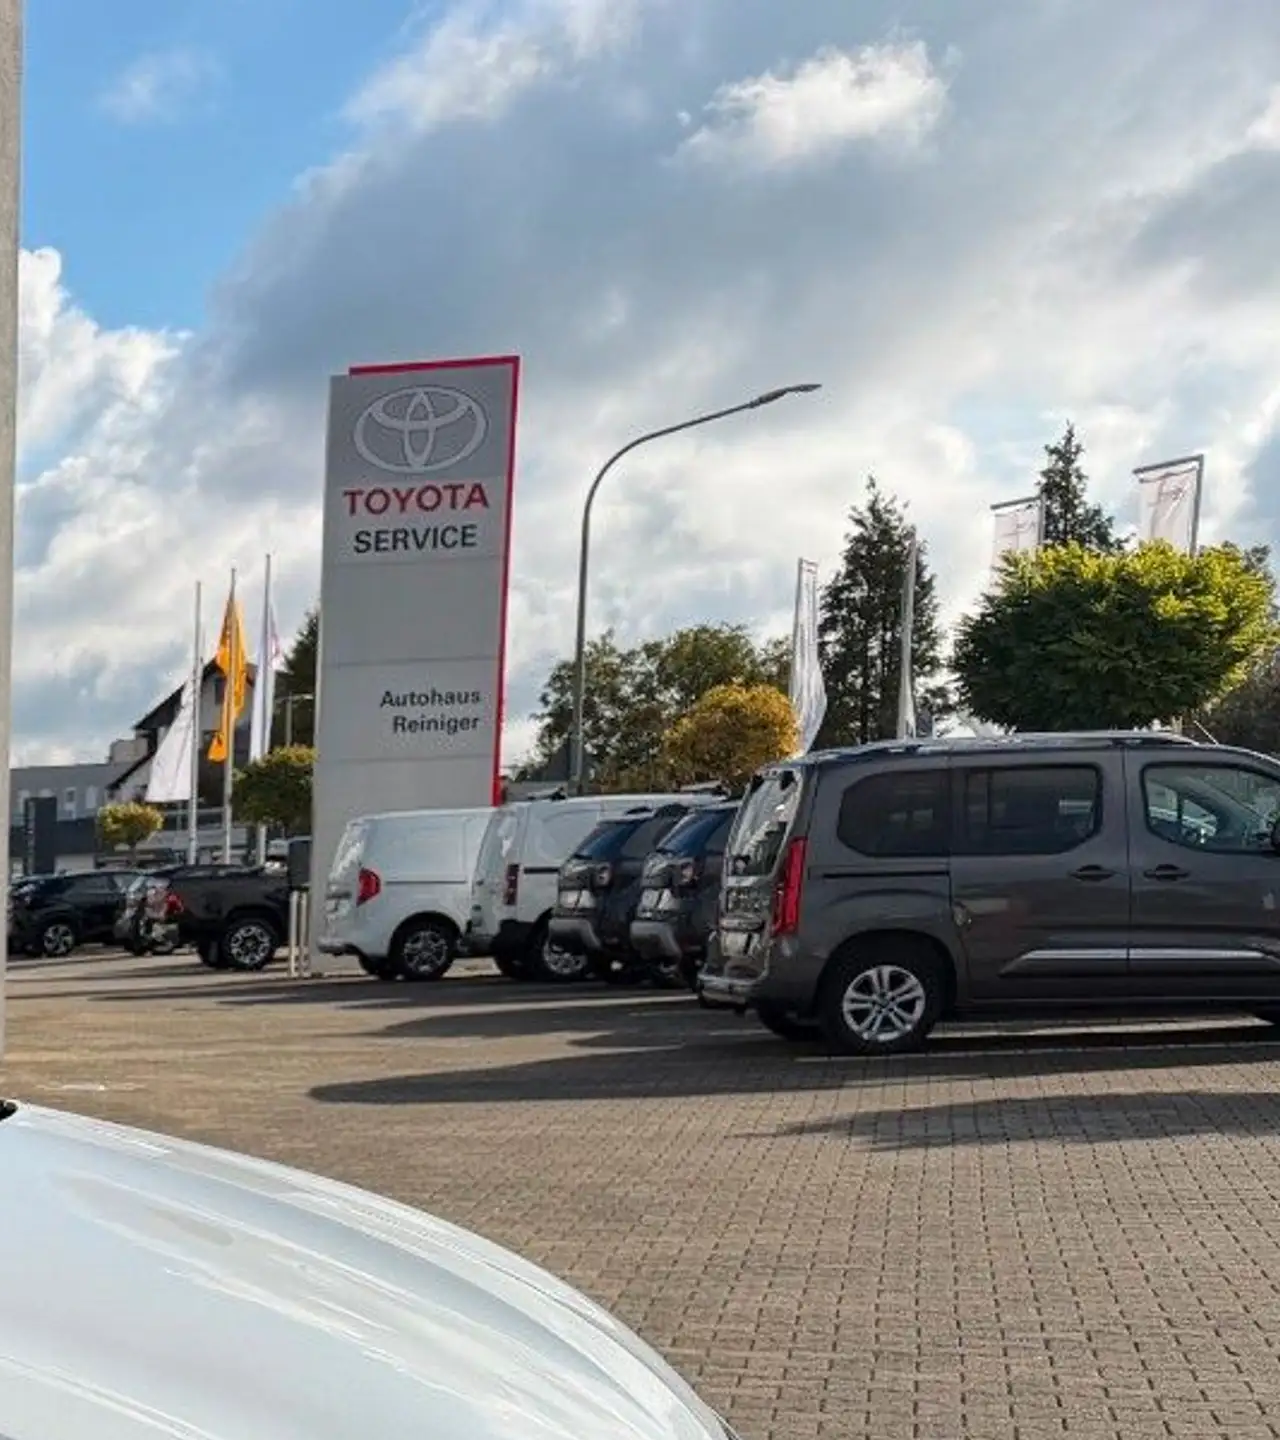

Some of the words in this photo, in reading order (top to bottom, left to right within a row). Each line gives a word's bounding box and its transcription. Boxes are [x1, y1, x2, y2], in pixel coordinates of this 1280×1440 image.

[344, 482, 489, 517] TOYOTA
[354, 524, 478, 554] SERVICE
[379, 689, 480, 711] Autohaus
[393, 714, 480, 735] Reiniger
